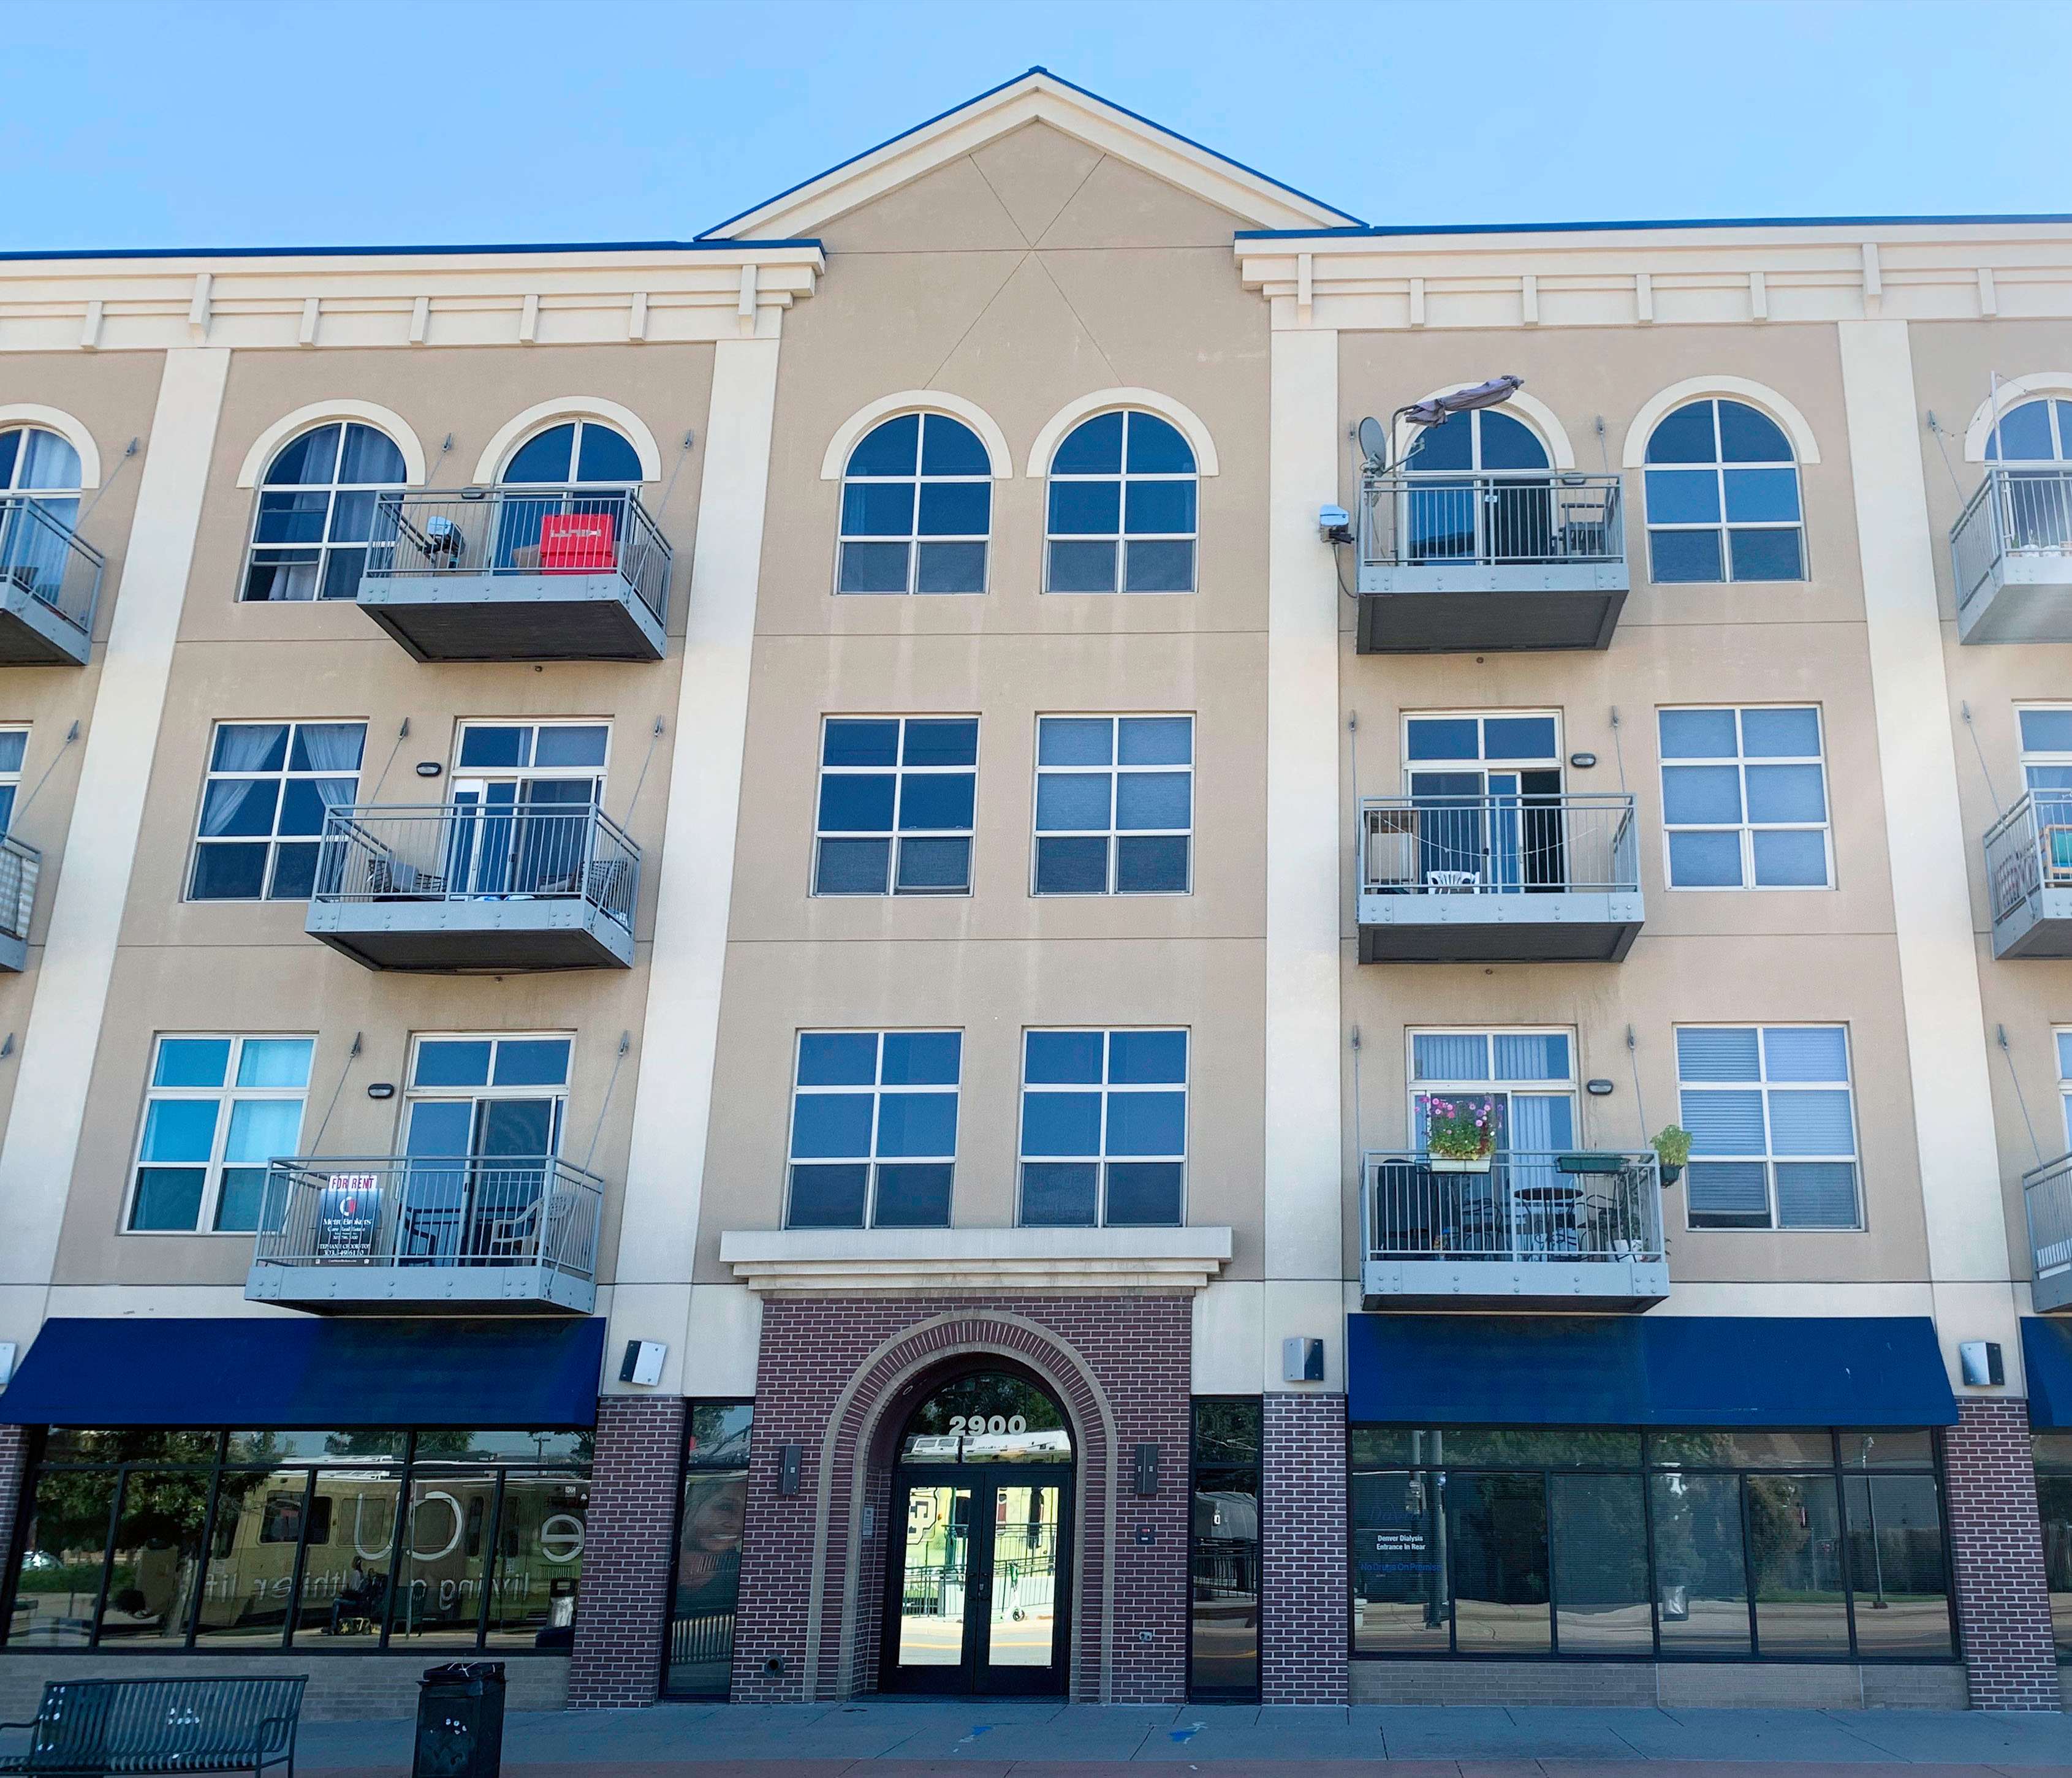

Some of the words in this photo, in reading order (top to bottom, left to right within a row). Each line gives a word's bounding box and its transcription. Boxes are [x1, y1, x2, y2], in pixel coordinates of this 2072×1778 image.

[332, 1178, 347, 1189] FOR
[352, 1178, 374, 1189] RENT
[949, 1415, 1027, 1436] 2900
